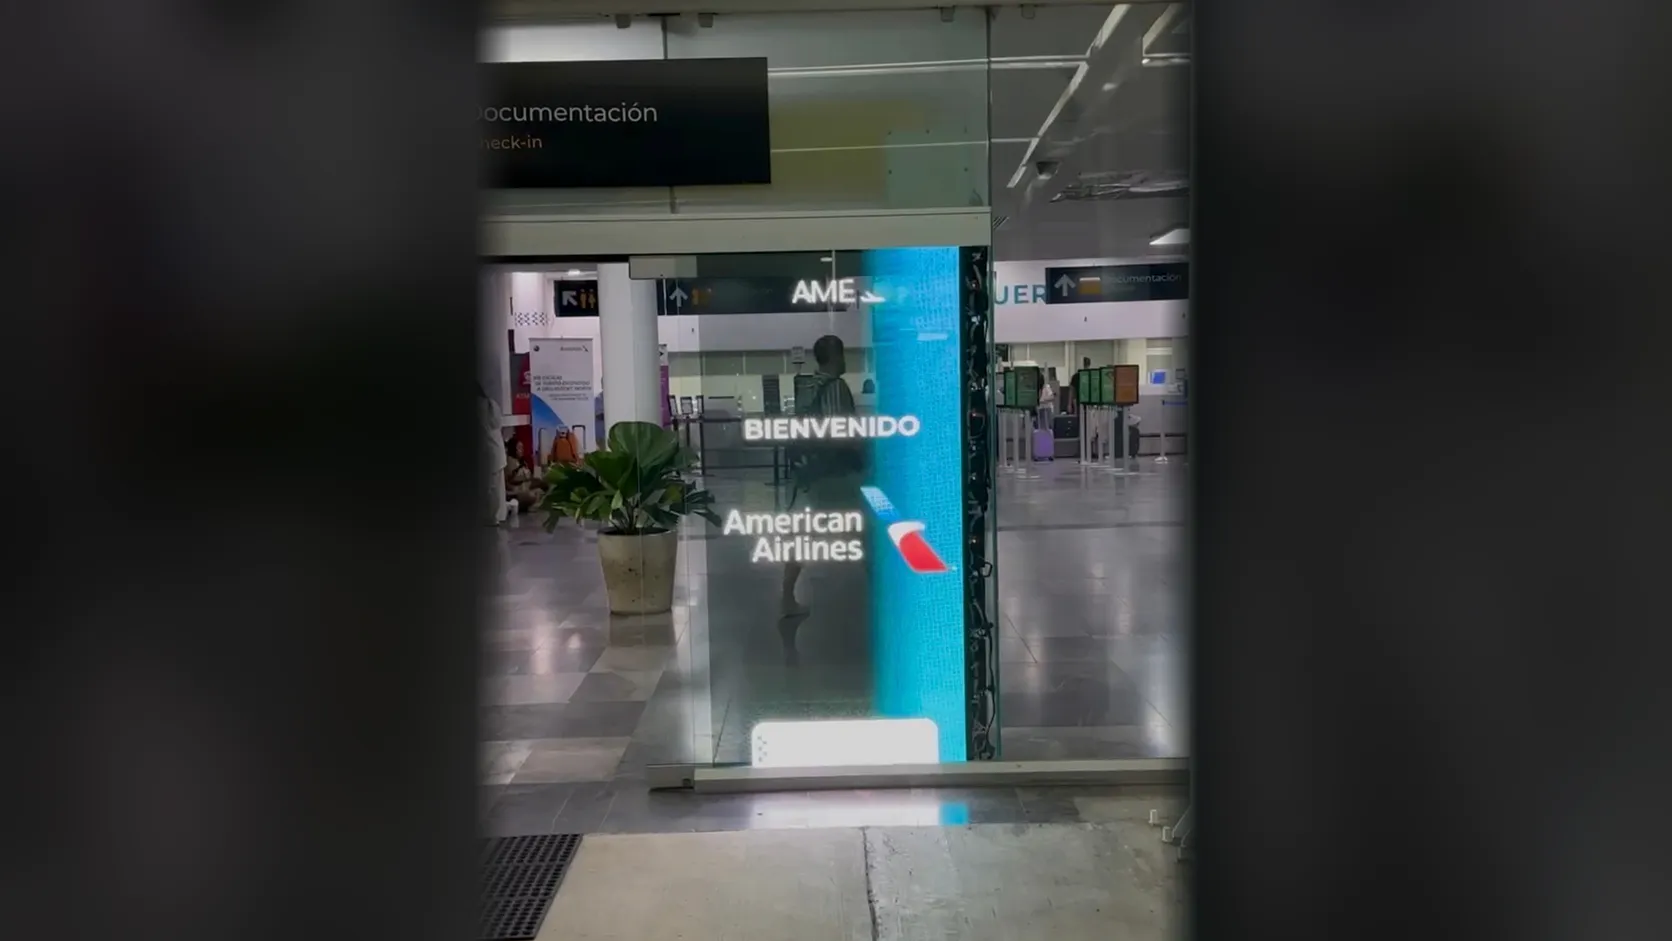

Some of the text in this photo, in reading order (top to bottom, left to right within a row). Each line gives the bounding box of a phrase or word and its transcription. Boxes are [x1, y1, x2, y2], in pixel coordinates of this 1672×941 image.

[480, 134, 543, 150] heck-in
[791, 278, 857, 305] AME
[743, 415, 921, 441] BIENVENIDO
[723, 506, 863, 536] American
[752, 536, 864, 563] Airlines
